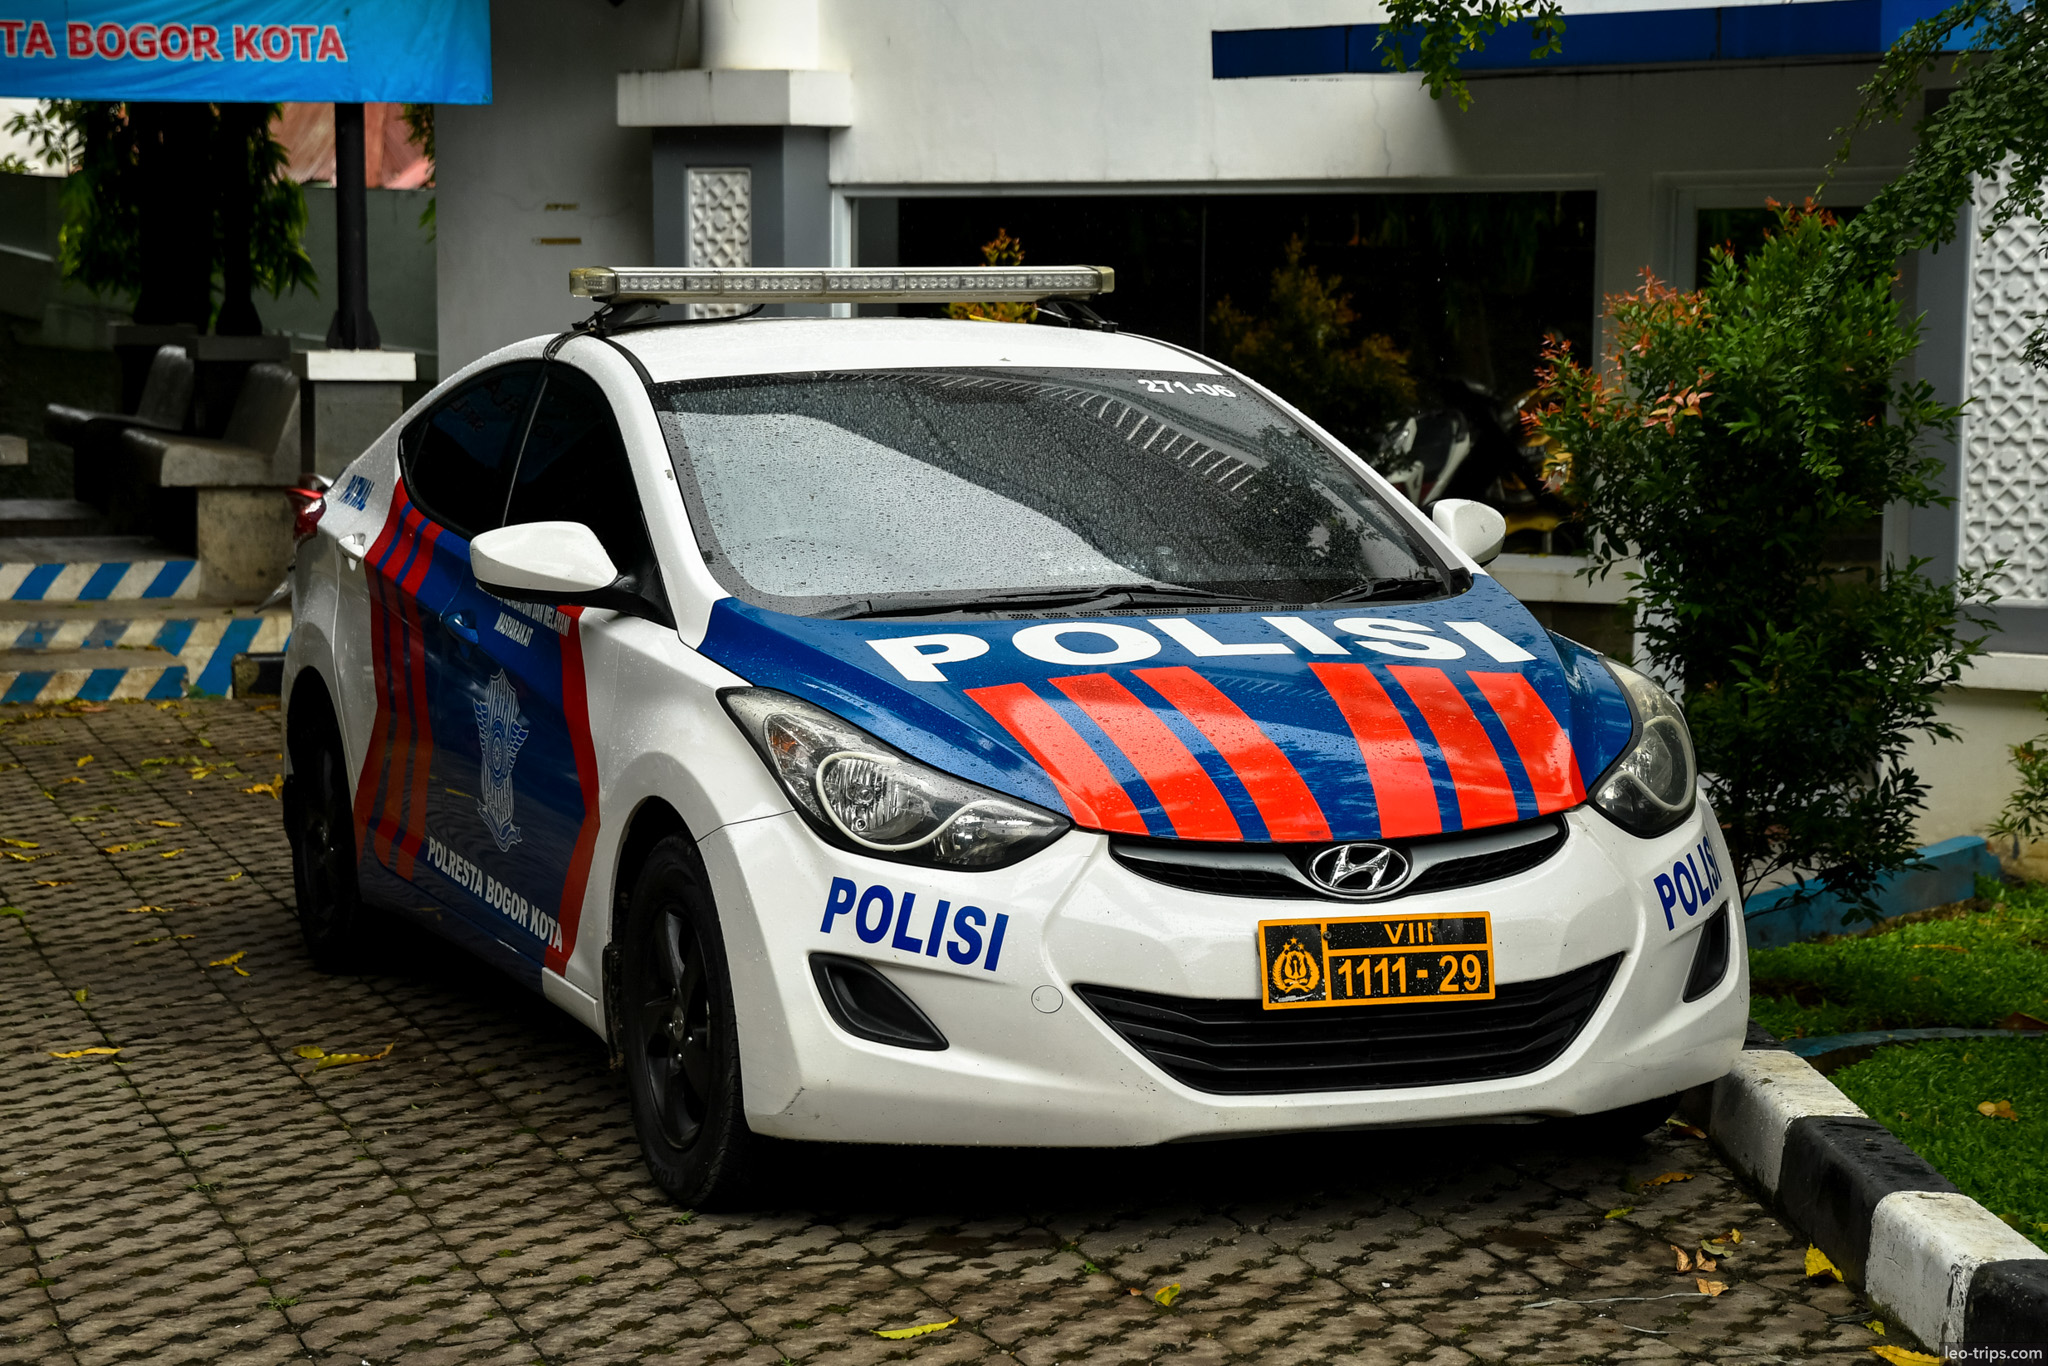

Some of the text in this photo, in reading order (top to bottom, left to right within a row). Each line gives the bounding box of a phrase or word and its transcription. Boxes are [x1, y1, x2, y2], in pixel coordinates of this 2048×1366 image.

[0, 20, 348, 62] TA BOGOR KOTA
[1137, 379, 1237, 398] 271-06
[865, 616, 1538, 682] POLISI
[427, 836, 563, 953] POLRESTA BOGOR KOTA
[1653, 831, 1722, 931] POLISI
[820, 876, 1009, 972] POLISI
[1384, 922, 1434, 944] VIII
